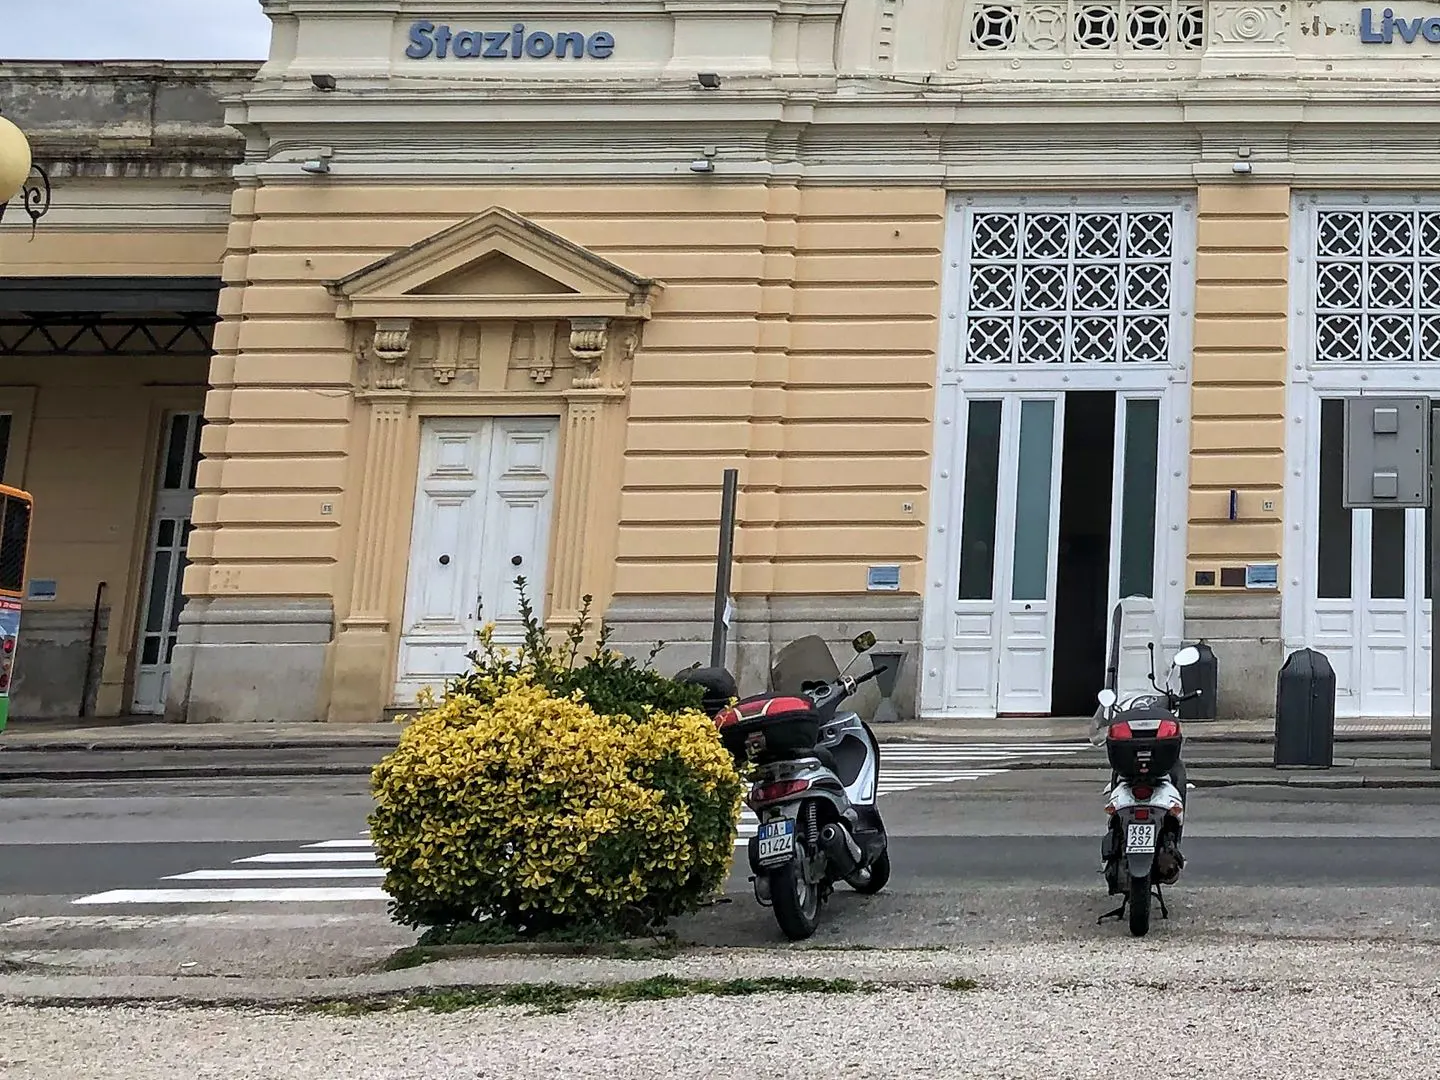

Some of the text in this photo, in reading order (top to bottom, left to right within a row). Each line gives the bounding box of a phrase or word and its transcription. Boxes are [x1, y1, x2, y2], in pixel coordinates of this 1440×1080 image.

[405, 19, 616, 59] Stazione
[1131, 825, 1152, 836] X82
[760, 837, 791, 856] 01424
[1130, 836, 1151, 846] 2S7
